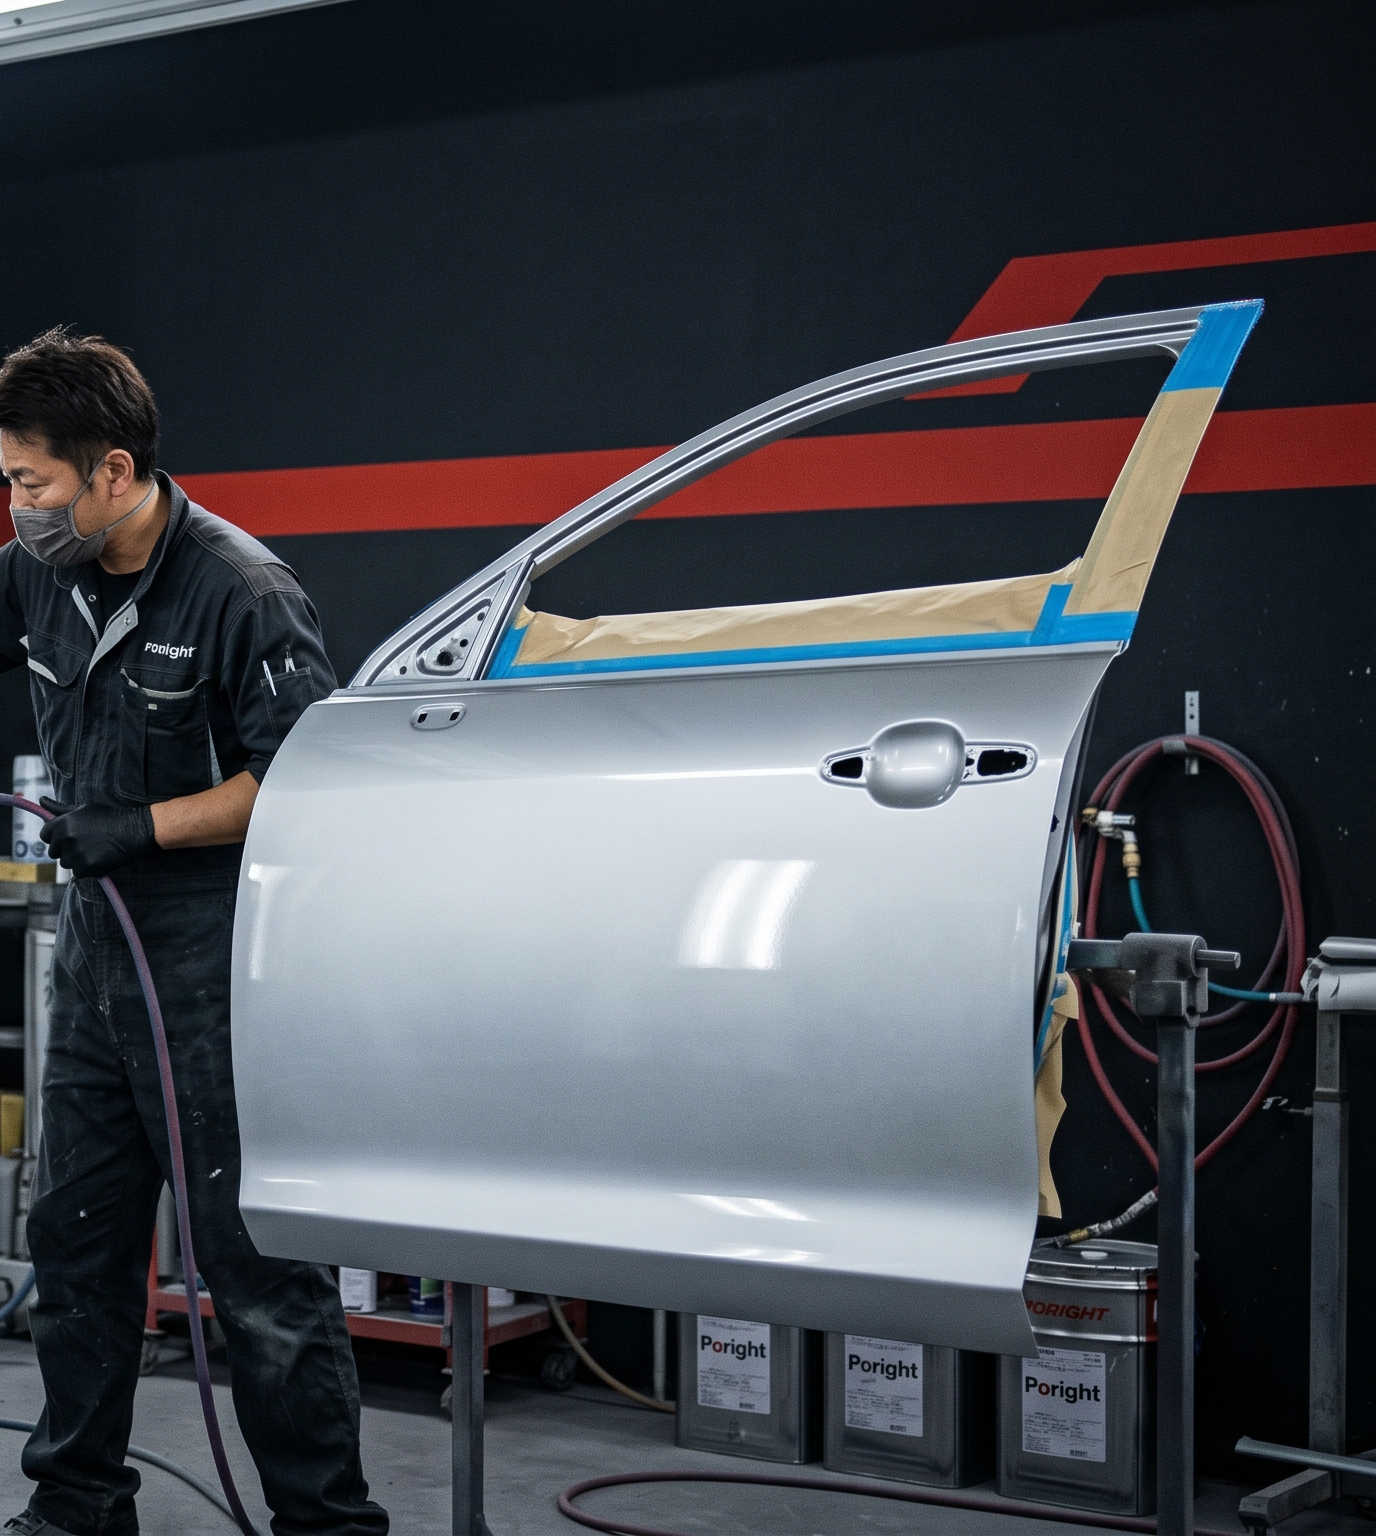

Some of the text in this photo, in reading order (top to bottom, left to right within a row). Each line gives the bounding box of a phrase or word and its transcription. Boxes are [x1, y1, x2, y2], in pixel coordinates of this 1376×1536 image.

[701, 1335, 767, 1360] Poright
[848, 1354, 918, 1380] Poright
[1025, 1376, 1101, 1404] Poright
